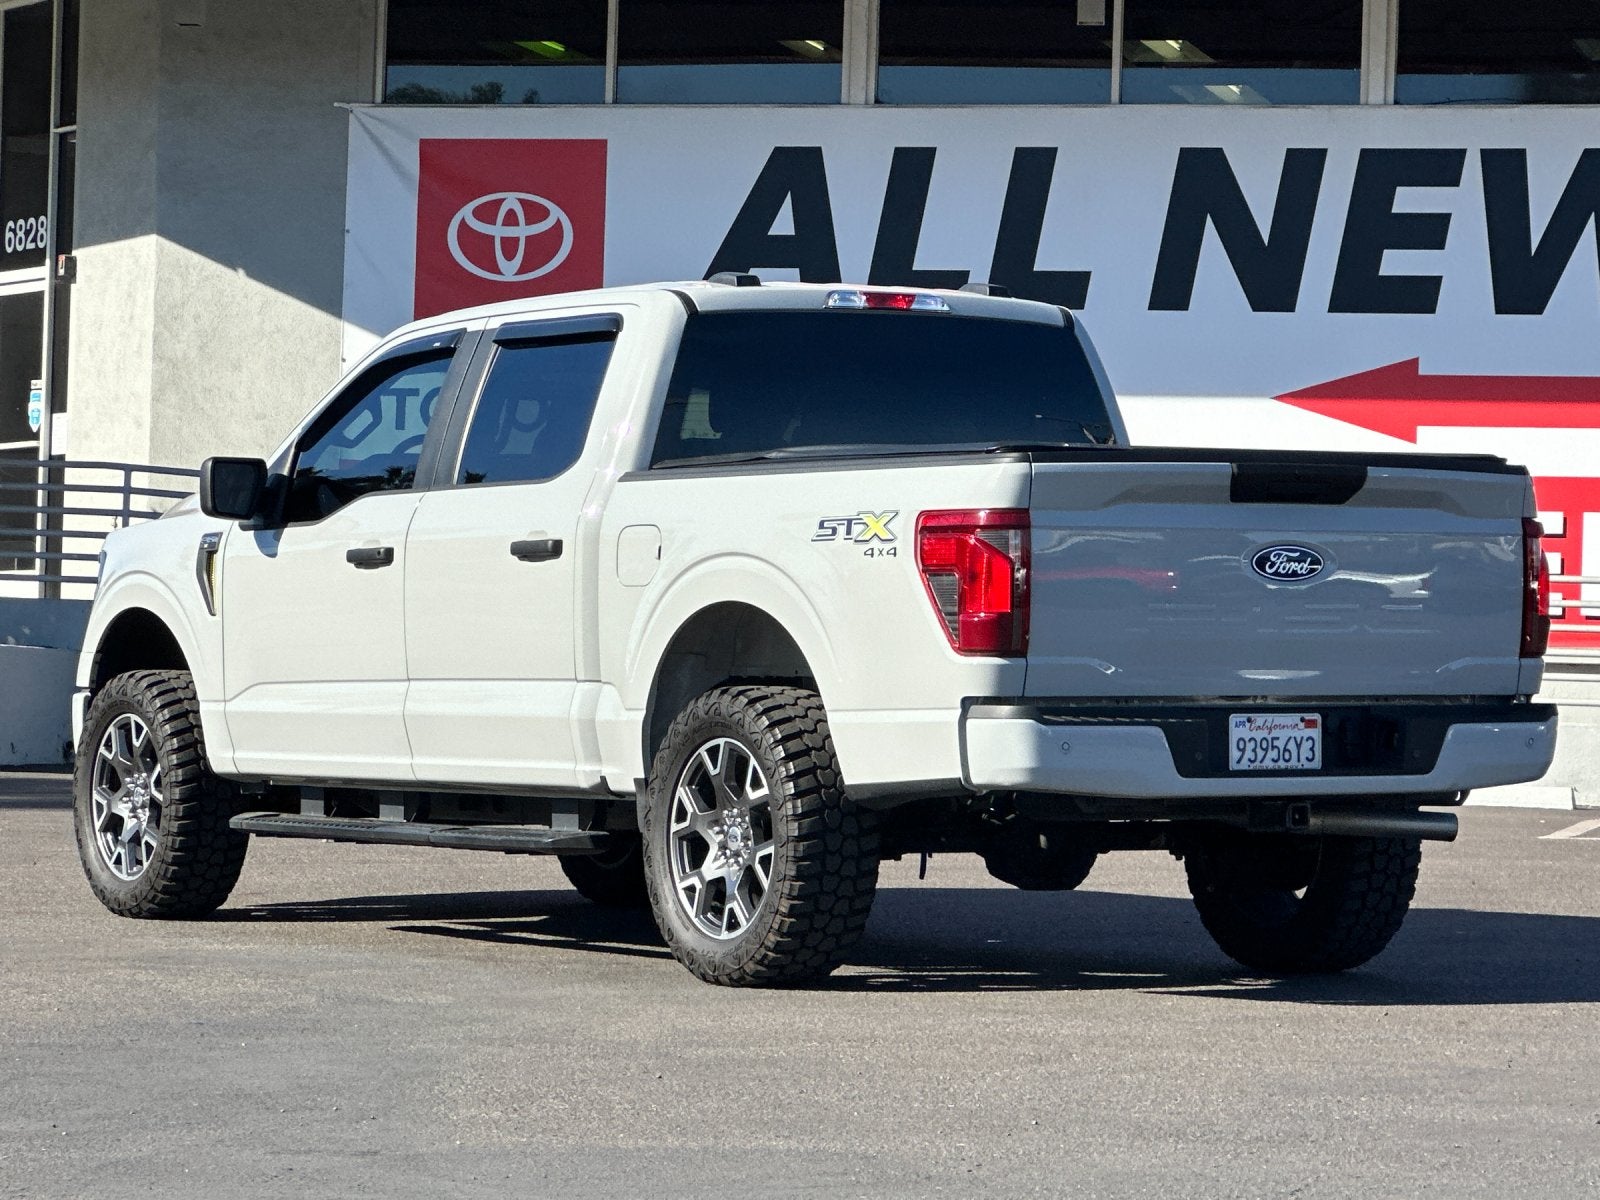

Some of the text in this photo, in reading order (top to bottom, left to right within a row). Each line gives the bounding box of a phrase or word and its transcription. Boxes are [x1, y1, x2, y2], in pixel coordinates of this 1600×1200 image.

[5, 215, 47, 253] 6828
[704, 146, 1093, 310] ALL
[811, 510, 899, 543] STX
[1265, 550, 1314, 574] Ford
[1234, 718, 1304, 735] APR California
[1236, 736, 1316, 764] 93956Y3
